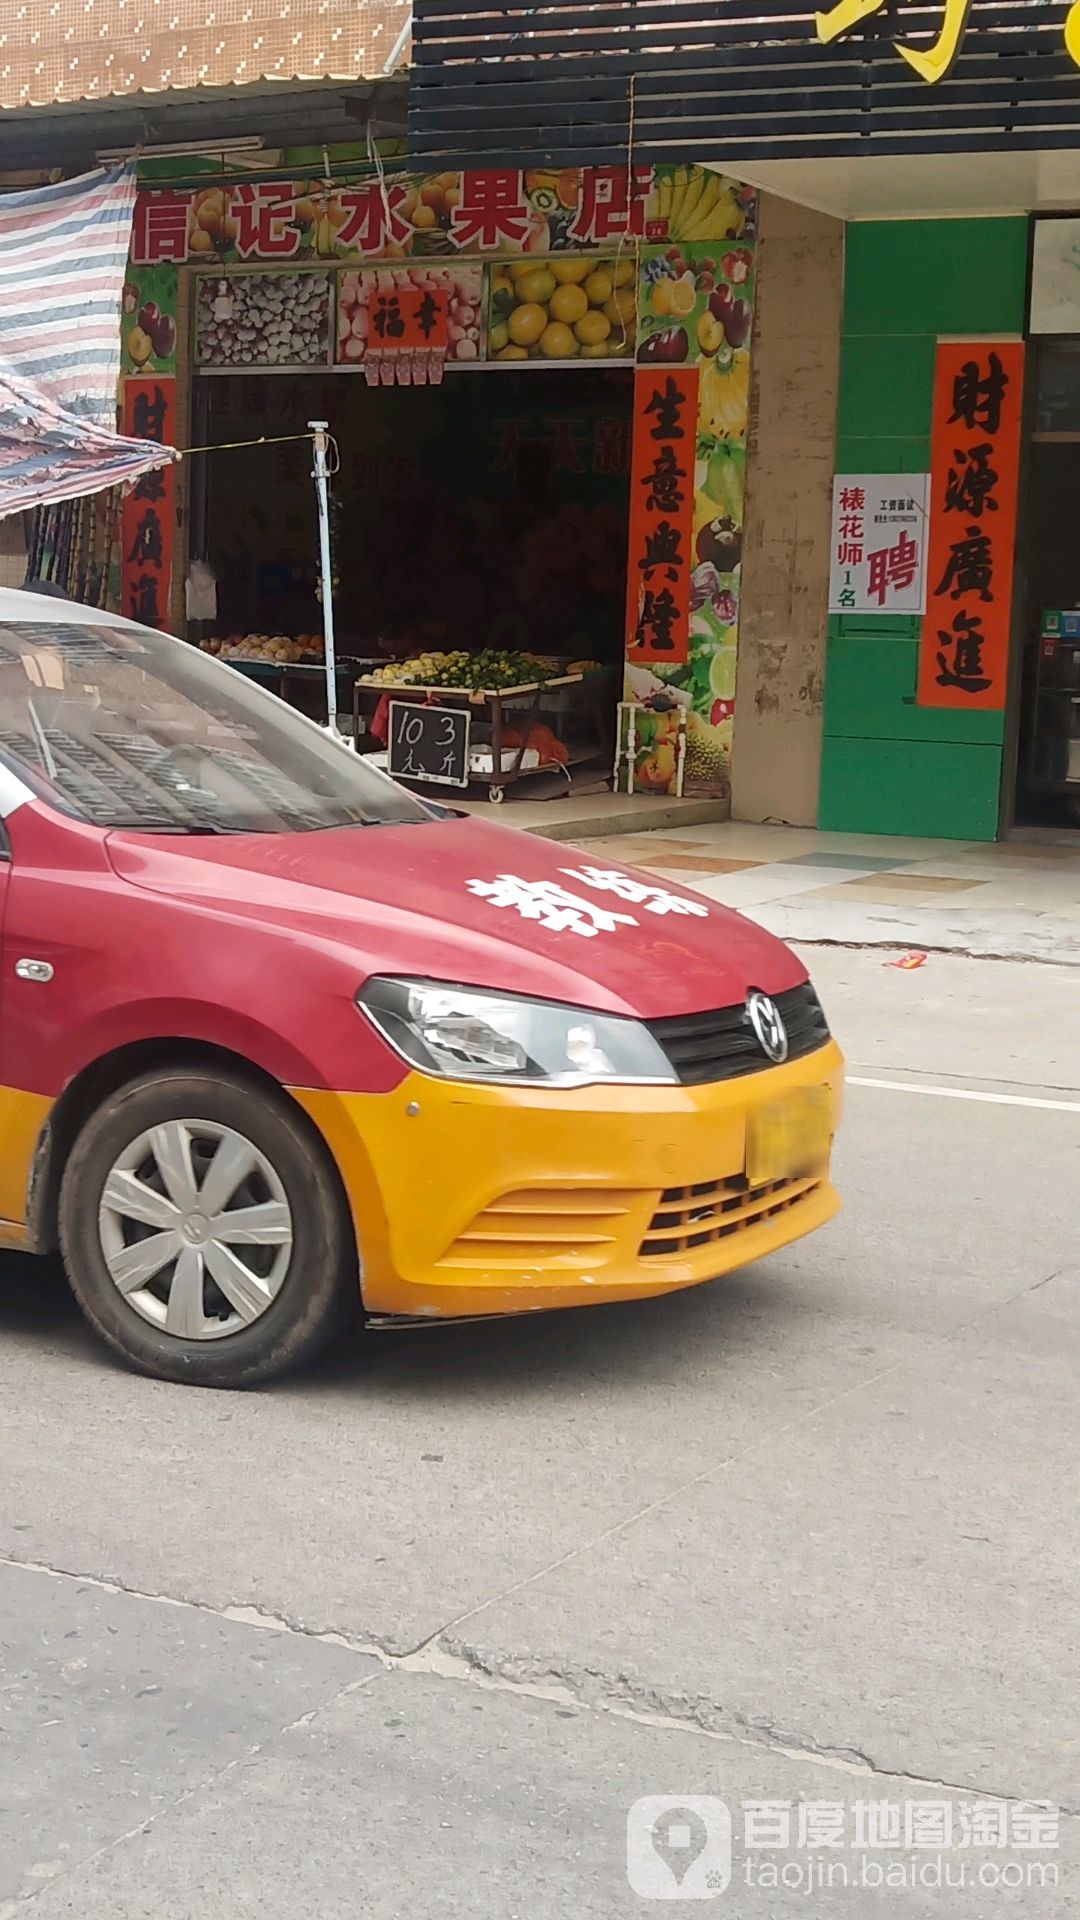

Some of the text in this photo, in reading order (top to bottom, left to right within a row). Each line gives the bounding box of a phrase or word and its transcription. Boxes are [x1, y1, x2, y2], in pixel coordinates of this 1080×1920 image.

[131, 165, 654, 264] 信记水果店
[867, 530, 918, 606] 聘
[397, 711, 456, 745] 10 3
